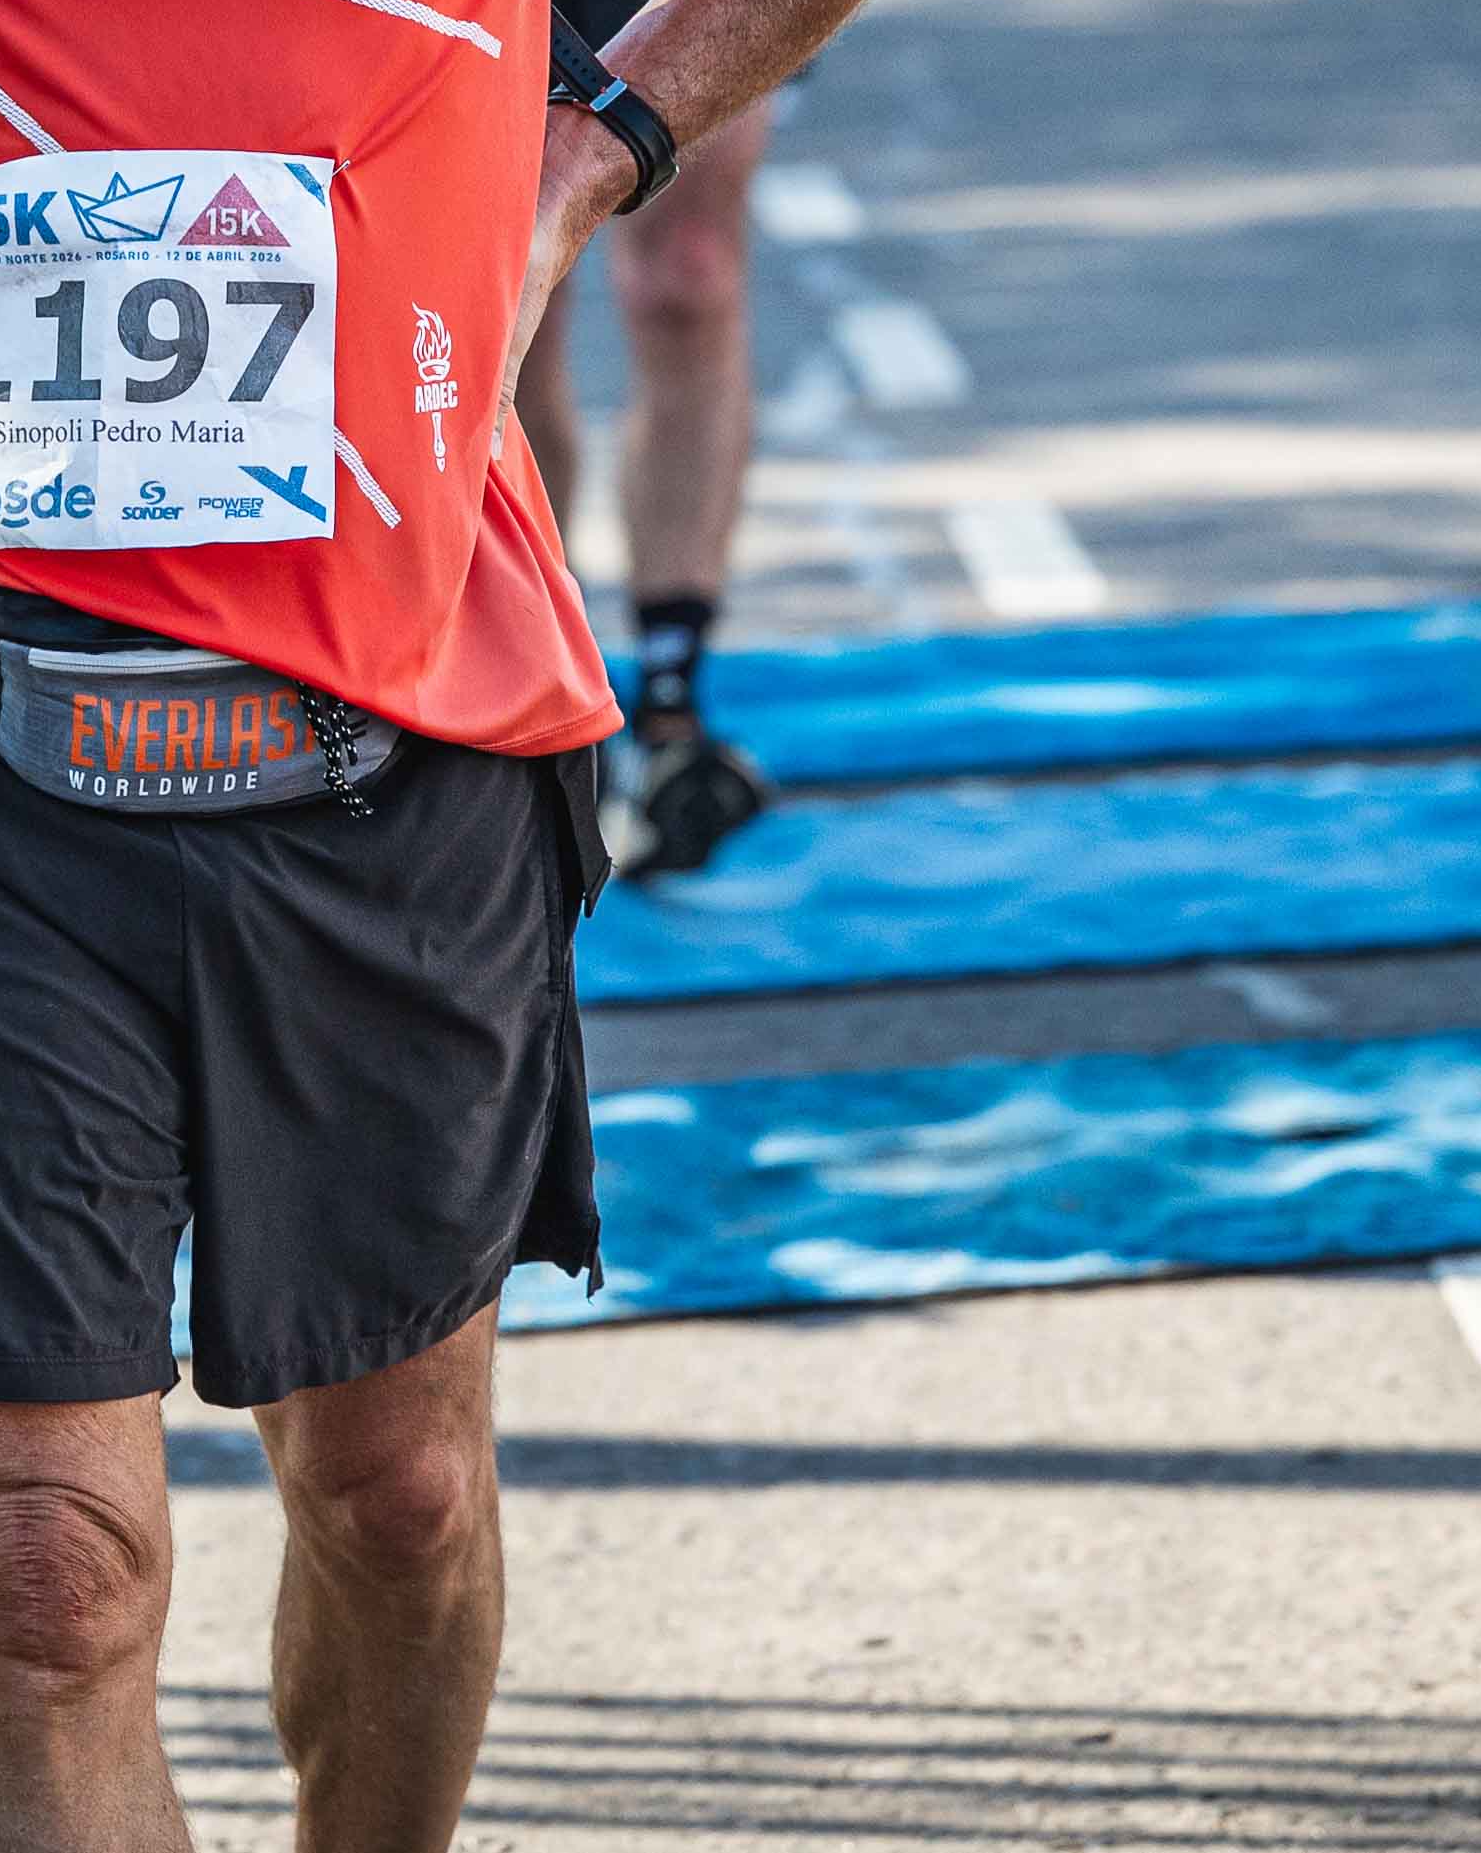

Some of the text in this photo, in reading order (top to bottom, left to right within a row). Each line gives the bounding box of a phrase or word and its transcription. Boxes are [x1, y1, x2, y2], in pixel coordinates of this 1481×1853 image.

[206, 207, 263, 238] 15K
[6, 254, 46, 265] NORTE
[51, 252, 82, 263] 2026
[96, 251, 150, 261] ROSARIO
[166, 251, 180, 261] 12
[186, 251, 202, 261] DE
[207, 251, 244, 262] ABRIL
[250, 251, 281, 263] 2026
[415, 381, 458, 413] ARDEC
[91, 419, 162, 445] Pedro
[171, 420, 245, 445] Maria
[198, 497, 264, 509] POWER
[224, 509, 261, 519] ADE
[68, 769, 259, 798] WORLDWIDE
